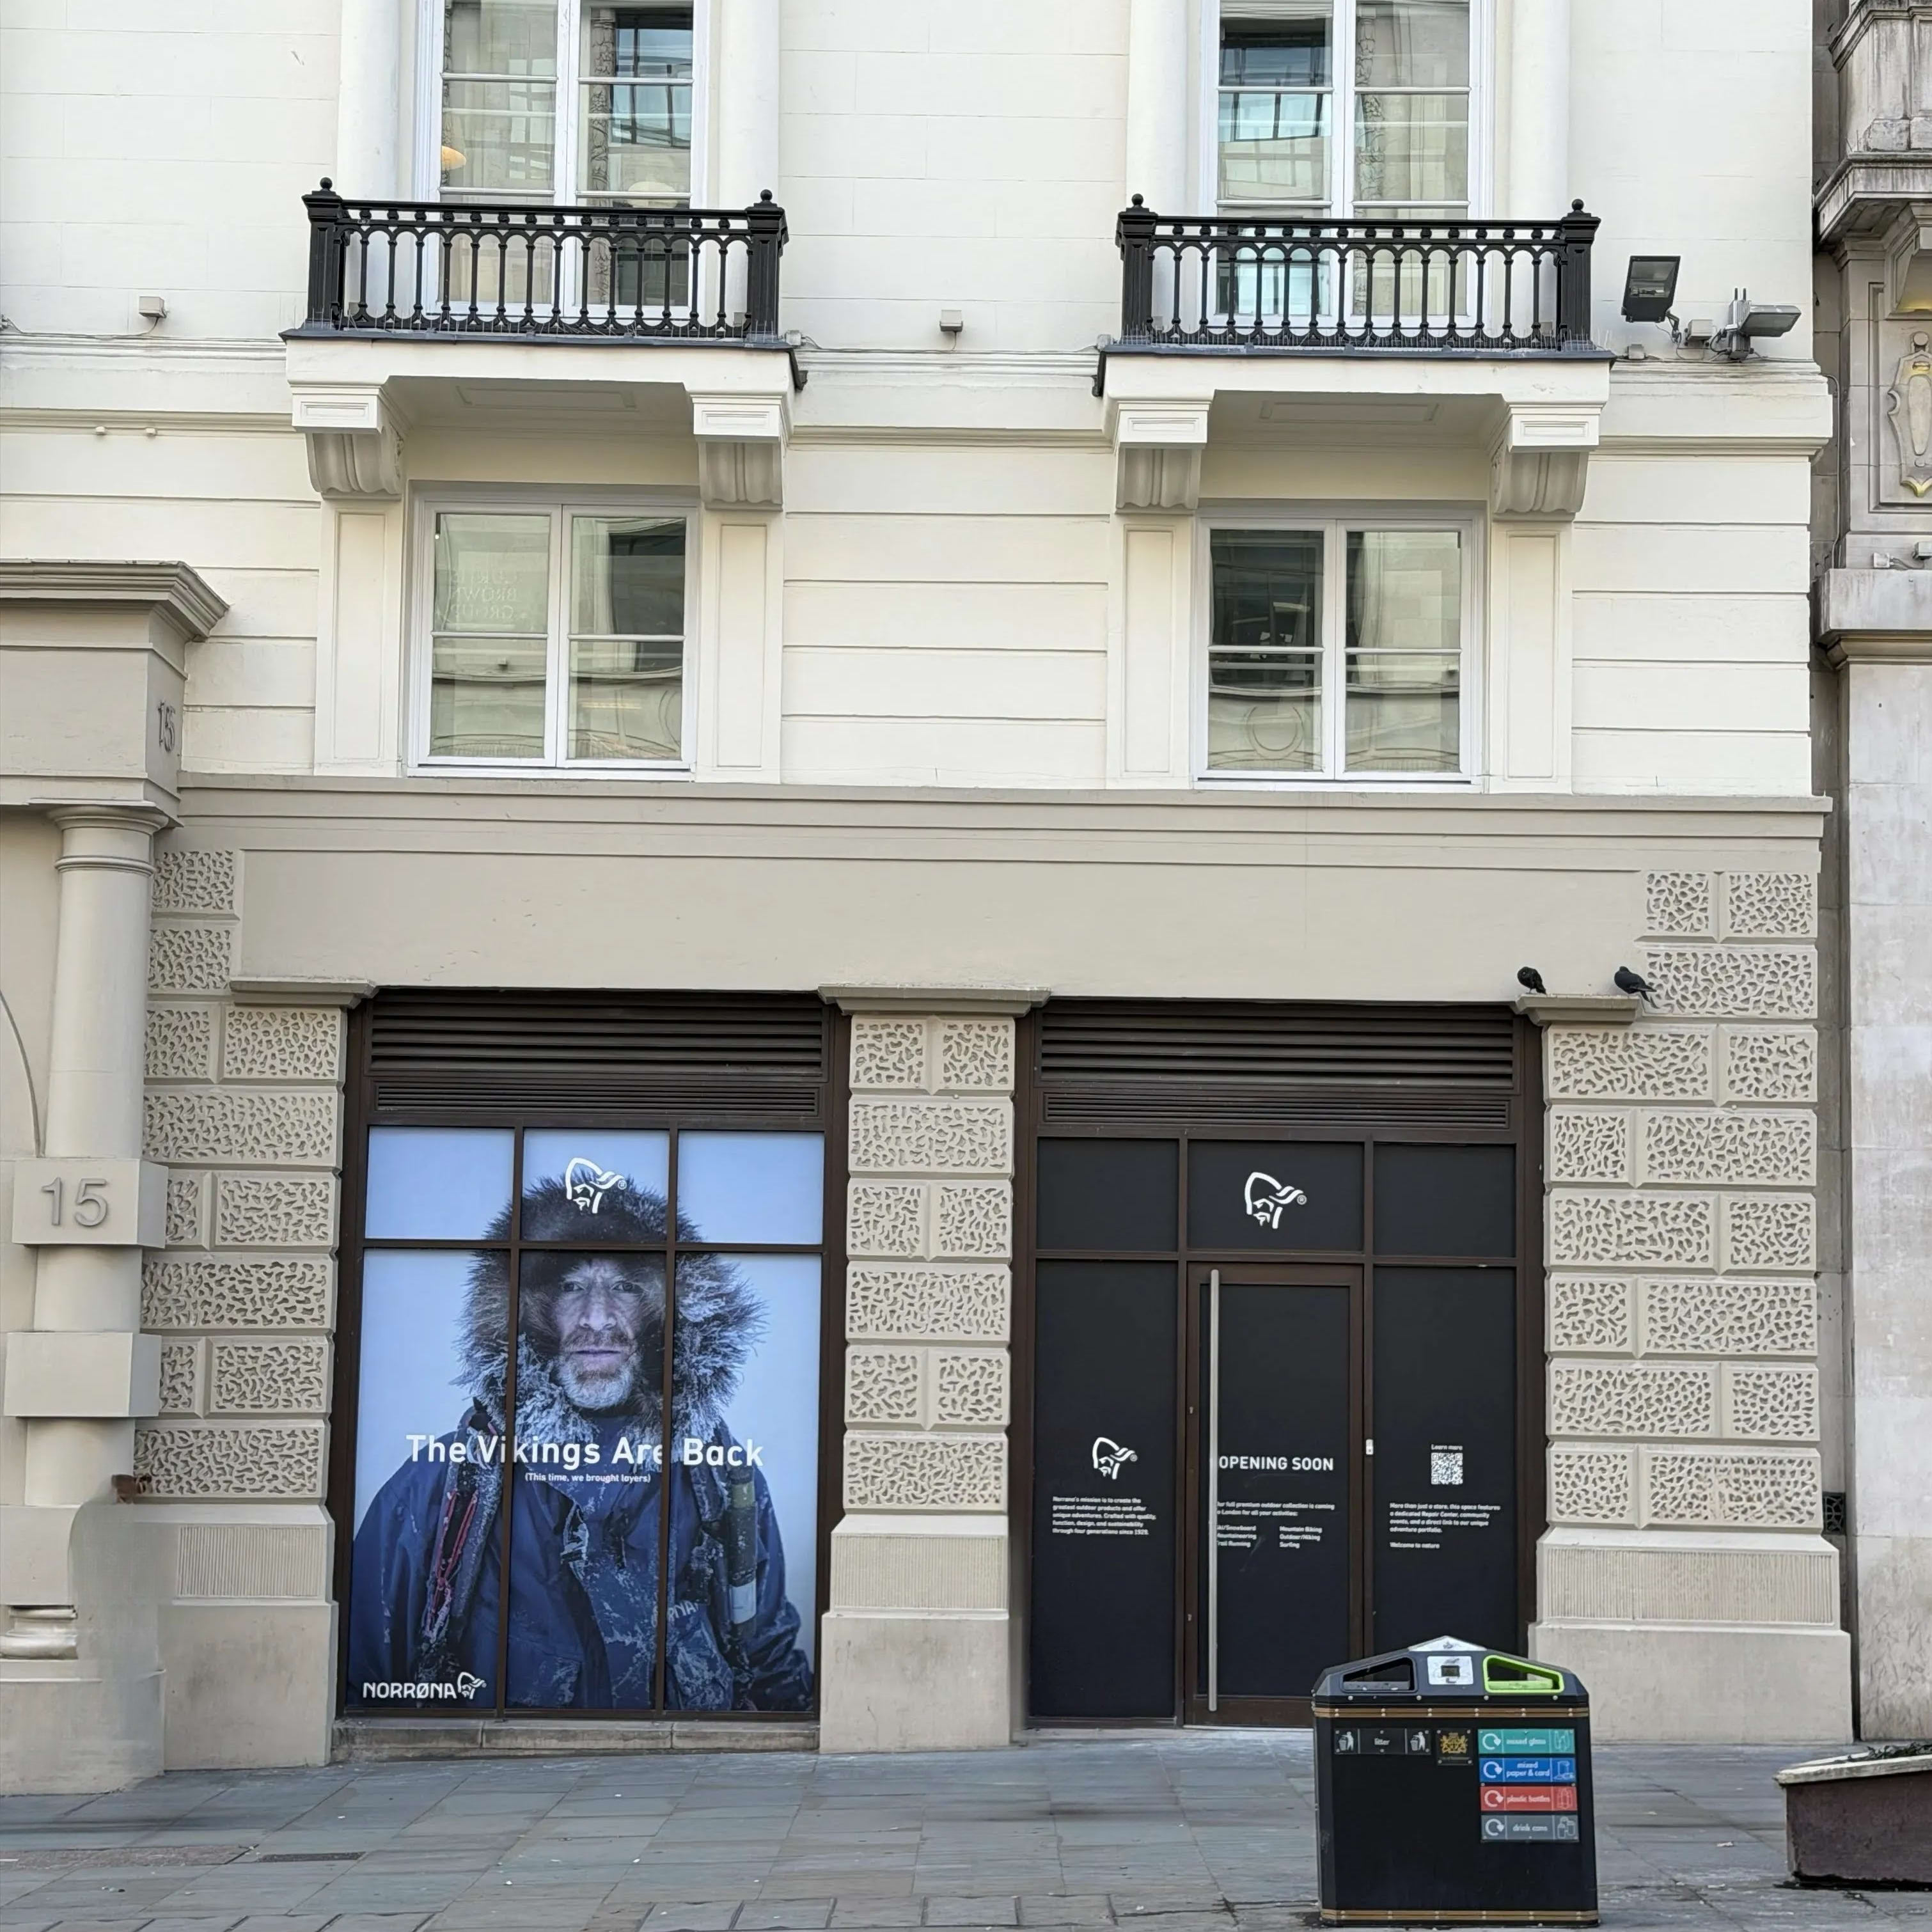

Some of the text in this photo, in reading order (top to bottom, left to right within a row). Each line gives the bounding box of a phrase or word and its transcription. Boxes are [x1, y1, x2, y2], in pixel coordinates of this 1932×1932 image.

[157, 701, 176, 752] 15
[40, 1176, 109, 1228] 15
[406, 1434, 466, 1463] The
[477, 1435, 600, 1470] Vikings
[684, 1438, 764, 1466] Back
[1219, 1456, 1333, 1470] OPENING SOON
[525, 1473, 546, 1481] (This
[548, 1473, 570, 1482] time,
[586, 1474, 619, 1483] brought
[622, 1474, 650, 1484] layers)
[363, 1682, 457, 1699] NORRØNA
